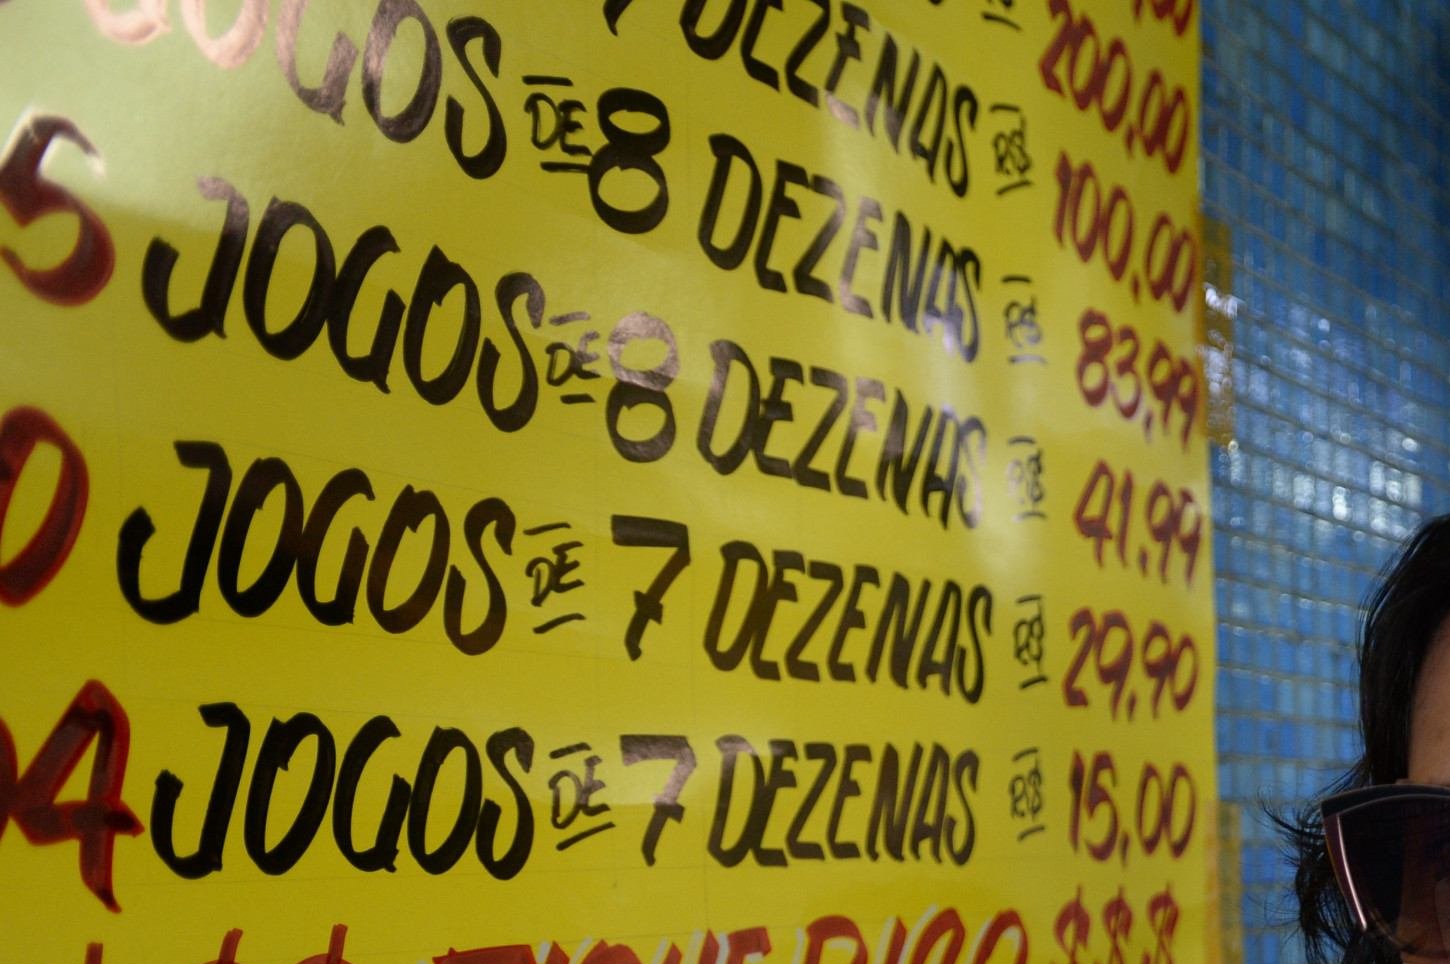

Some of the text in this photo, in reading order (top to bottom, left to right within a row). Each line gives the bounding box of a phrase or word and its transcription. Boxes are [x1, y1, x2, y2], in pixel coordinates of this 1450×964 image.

[141, 176, 546, 432] JOGOS
[545, 331, 601, 386] DE
[606, 311, 680, 462] 8
[697, 339, 987, 530] DEZENAS
[523, 91, 594, 156] DE
[588, 86, 670, 234] 8
[698, 133, 980, 362] DEZENAS
[116, 440, 516, 656] JOGOS
[525, 541, 585, 607] DE
[610, 513, 690, 661] 7
[704, 540, 993, 703] DEZENAS
[0, 680, 145, 913] 4
[150, 701, 535, 880] JOGOS
[549, 752, 610, 828] DE
[619, 734, 697, 866] 7
[706, 734, 979, 867] DEZENAS
